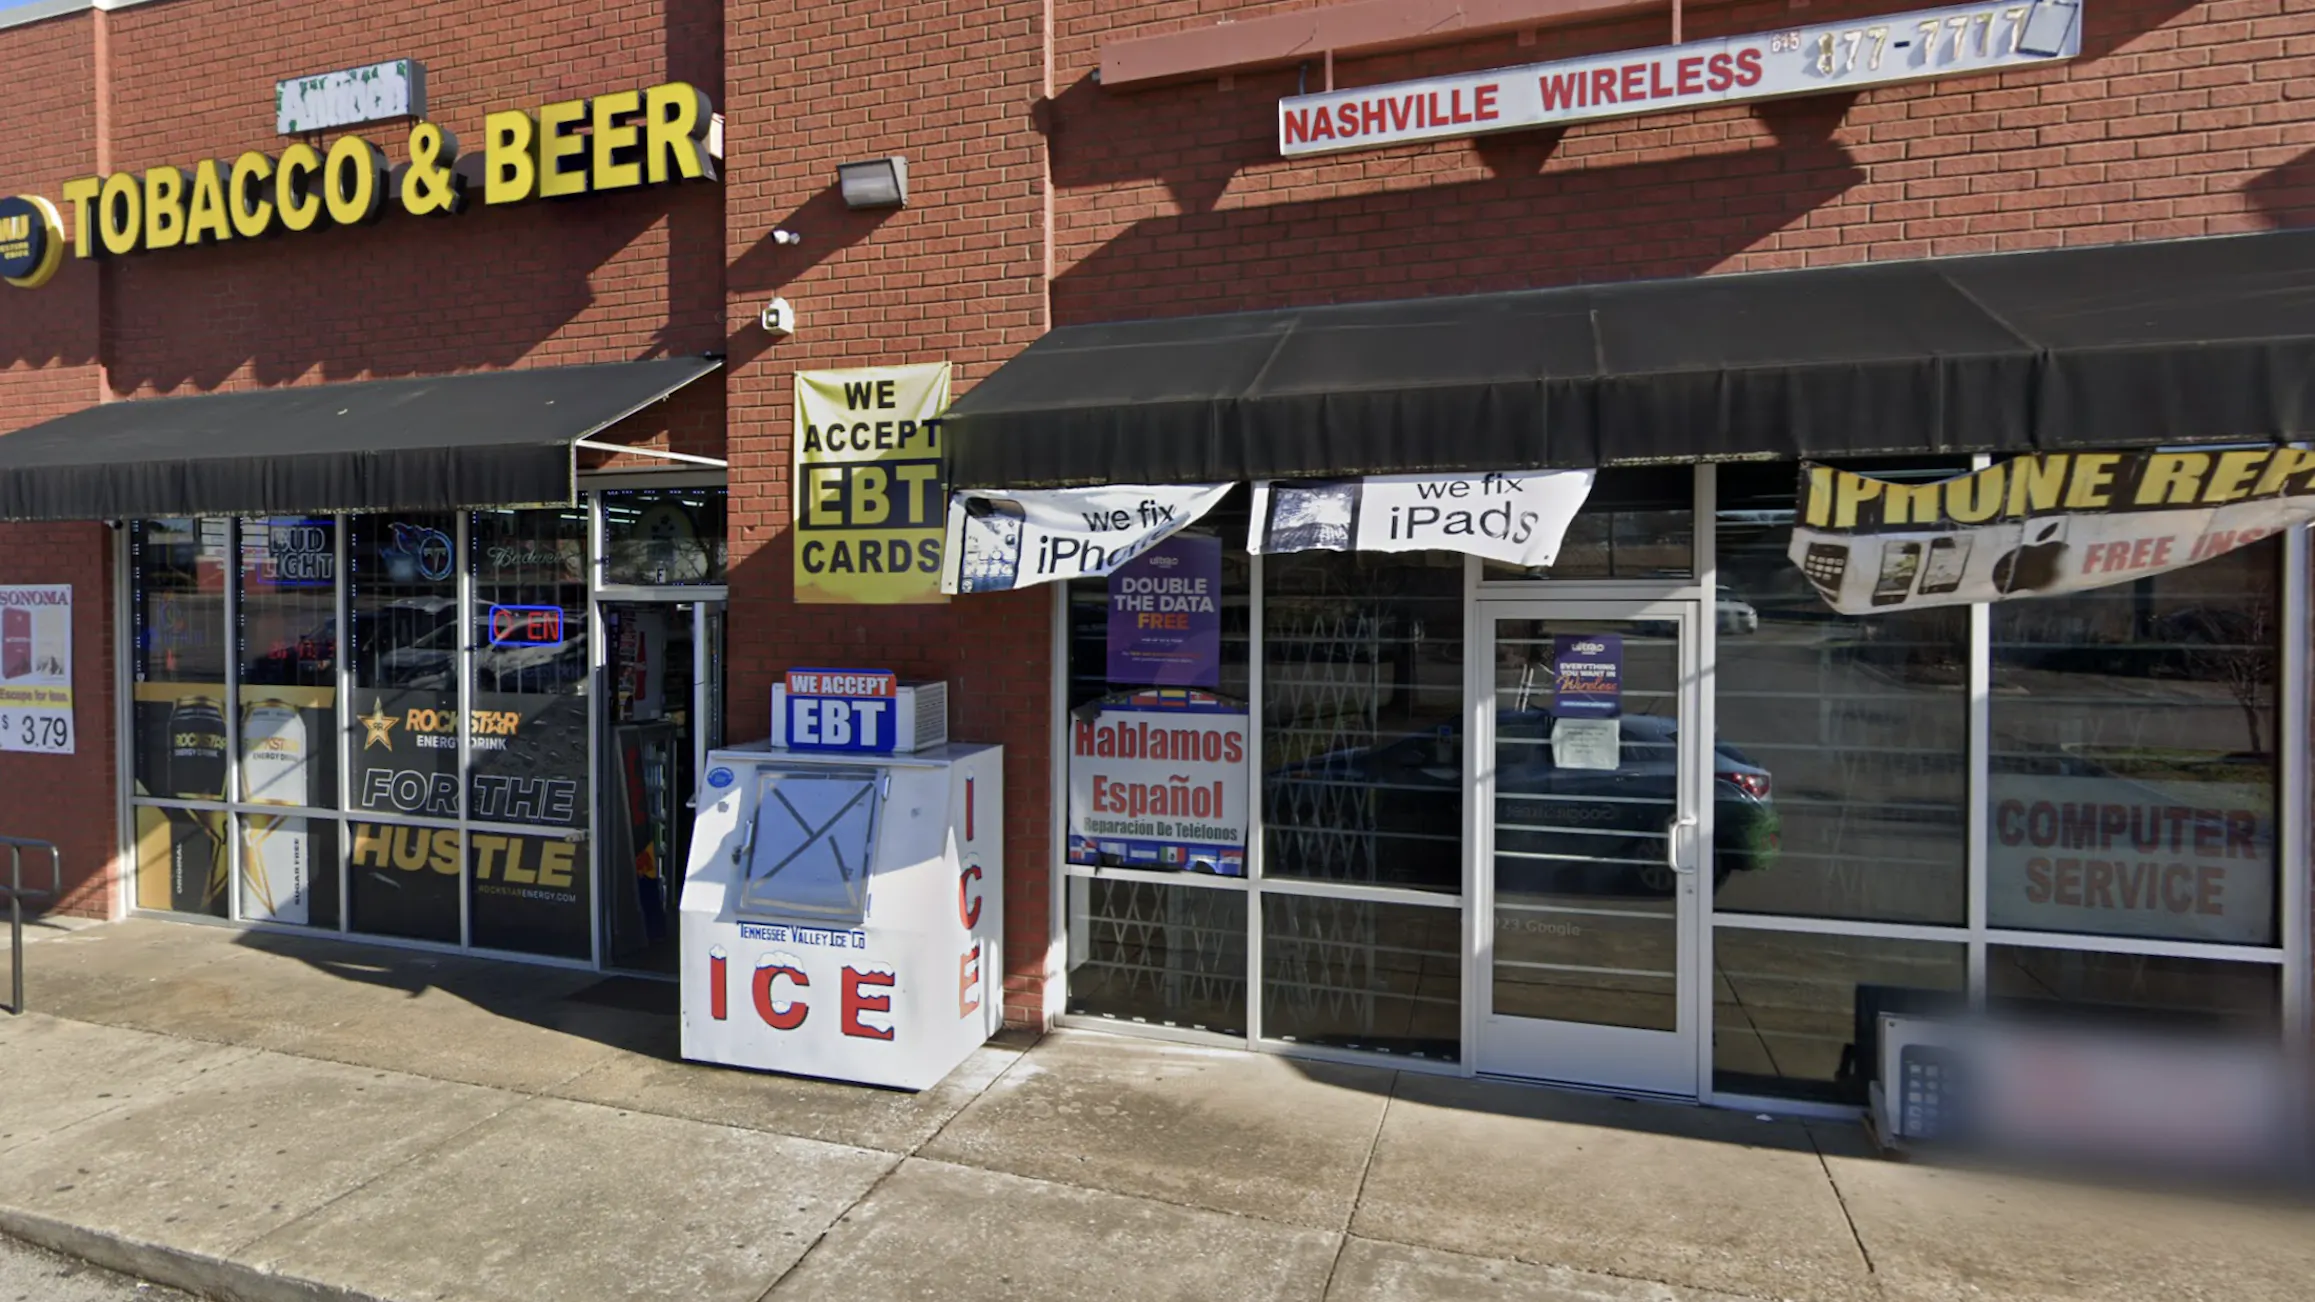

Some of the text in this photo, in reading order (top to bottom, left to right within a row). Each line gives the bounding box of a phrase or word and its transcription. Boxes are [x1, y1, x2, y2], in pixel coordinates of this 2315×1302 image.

[1284, 48, 1763, 145] NASHVILLE WIRELESS
[63, 136, 374, 258] TOBACCO
[401, 122, 459, 215] &
[484, 82, 702, 205] BEER
[844, 379, 896, 410] WE
[802, 418, 941, 453] ACCEPT
[808, 464, 939, 526] EBT
[1417, 473, 1523, 500] we fix
[1806, 454, 2121, 527] IPHONE
[1082, 500, 1174, 531] we fix
[1391, 501, 1539, 544] iPads
[271, 526, 326, 552] BUD
[802, 538, 941, 574] CARDS
[2081, 535, 2176, 575] FREE
[0, 591, 68, 605] SONOMA
[1121, 577, 1208, 594] DOUBLE
[1115, 595, 1214, 613] THE DATA
[1137, 612, 1190, 630] FREE
[494, 610, 559, 640] OEN
[1560, 662, 1616, 670] EVERYTHING
[791, 675, 889, 695] WE ACCEPT
[2, 714, 68, 747] $ 3.79
[405, 708, 520, 735] ROCKSTAR
[793, 699, 886, 746] EBT
[1075, 721, 1243, 763] Hablamos
[362, 768, 460, 813] FOR
[474, 775, 577, 821] THE
[1092, 774, 1223, 819] Español
[1084, 817, 1238, 841] Reparación De Teléfonos
[1996, 799, 2258, 860] COMPUTER
[353, 824, 577, 888] HUSTLE
[958, 766, 983, 1020] ICE
[2025, 857, 2225, 916] SERVICE
[738, 922, 786, 943] TENNESSEE
[709, 946, 896, 1041] ICE
